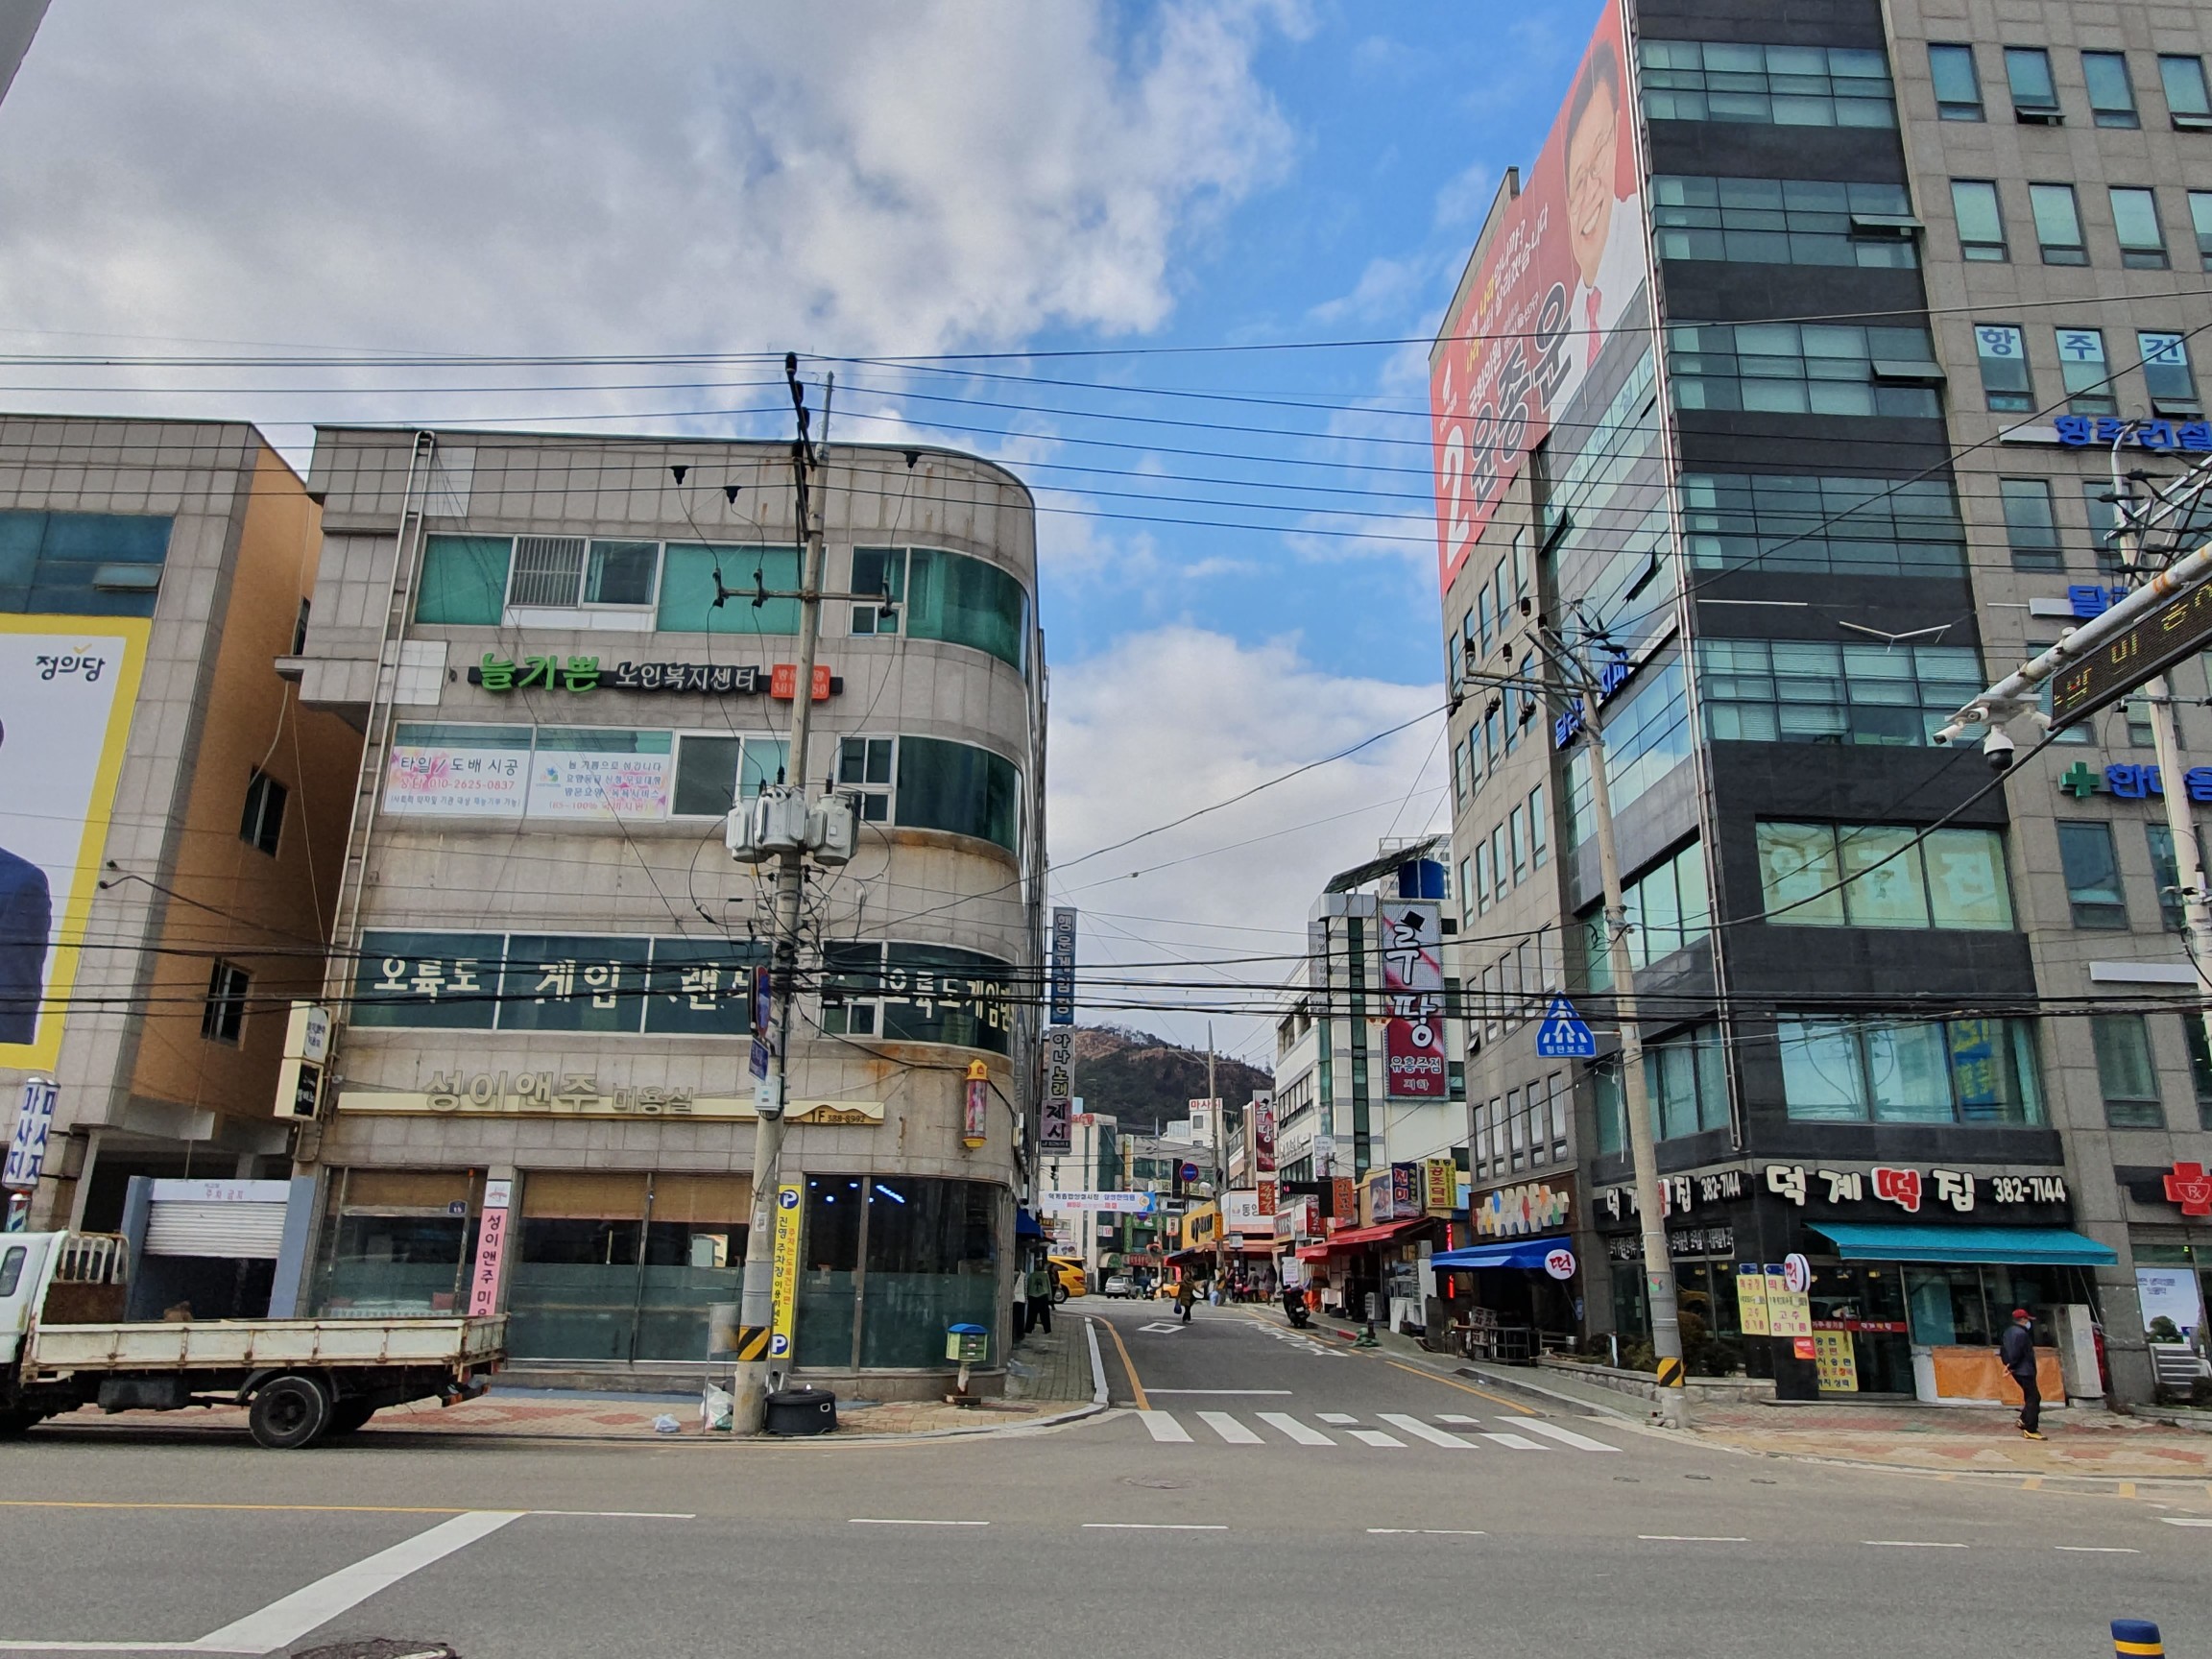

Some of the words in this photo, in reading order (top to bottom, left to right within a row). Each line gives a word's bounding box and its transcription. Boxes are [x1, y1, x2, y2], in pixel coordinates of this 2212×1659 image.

[1496, 202, 1550, 318] 살리겠습니다
[1469, 346, 1502, 417] 국회의원
[1470, 281, 1575, 517] 윤종운
[1442, 425, 1470, 570] 2
[36, 655, 106, 682] 정의당
[480, 652, 601, 693] 늘기쁜
[615, 661, 756, 691] 노인복지센터
[400, 757, 432, 774] 타일
[450, 757, 482, 773] 도배
[488, 758, 518, 776] 시공
[429, 779, 516, 790] 010-2625-0837
[373, 957, 481, 1004] 오륙도
[534, 958, 621, 1009] 게임
[1389, 1055, 1442, 1073] 유흥주점
[423, 1070, 600, 1112] 성이앤주
[612, 1083, 694, 1116] 미용실
[1403, 1078, 1430, 1091] 지하
[809, 1110, 826, 1124] 1F
[1046, 1103, 1067, 1140] 제시
[782, 1191, 798, 1208] P
[1700, 1171, 1742, 1202] 382-7144
[1765, 1164, 1976, 1214] 덕계떡집
[1991, 1175, 2067, 1205] 382-7144
[480, 1214, 501, 1285] 성이앤주
[774, 1242, 786, 1277] 주차장
[1549, 1254, 1573, 1275] 떡
